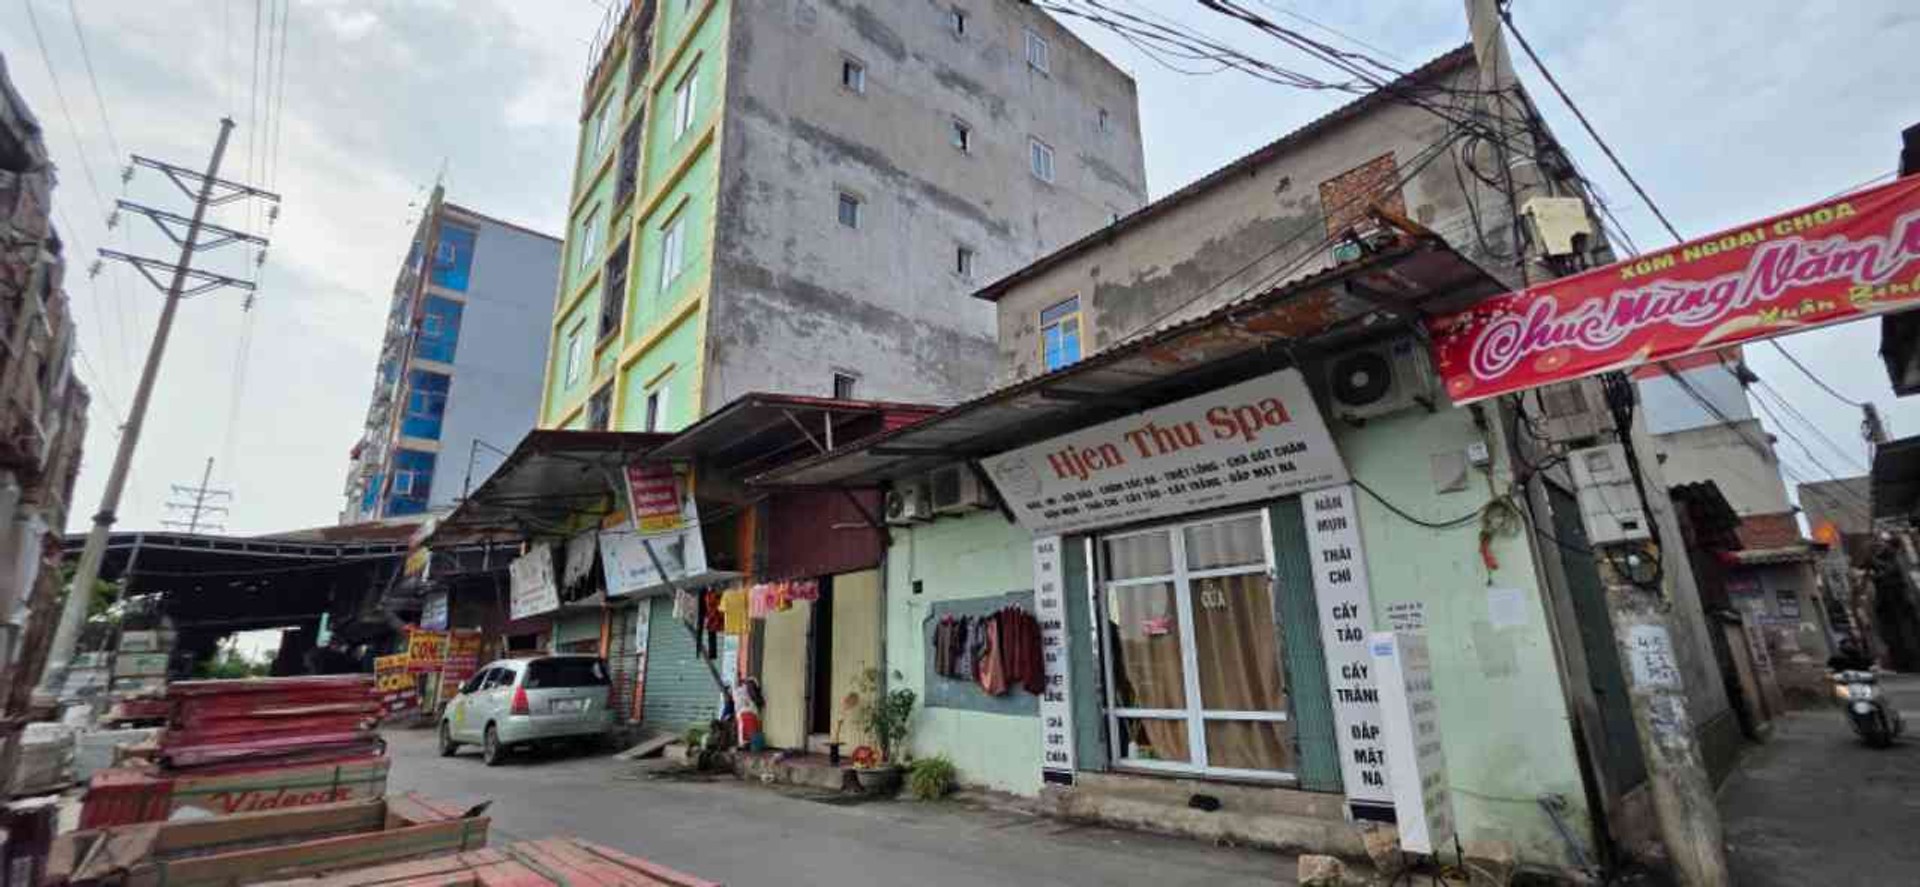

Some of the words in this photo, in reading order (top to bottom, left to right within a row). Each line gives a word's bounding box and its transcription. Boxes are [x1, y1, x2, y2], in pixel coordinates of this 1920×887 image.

[1470, 296, 1624, 379] Chúc
[1605, 277, 1742, 332] Mừng
[1742, 238, 1900, 304] Năm
[1124, 418, 1203, 459] Thu
[1205, 397, 1292, 443] Spa
[1332, 600, 1358, 621] CẤY
[1341, 659, 1368, 680] CẤY
[1351, 719, 1380, 741] ĐẮP
[1353, 747, 1385, 769] MẶT
[1361, 769, 1385, 788] NẠ
